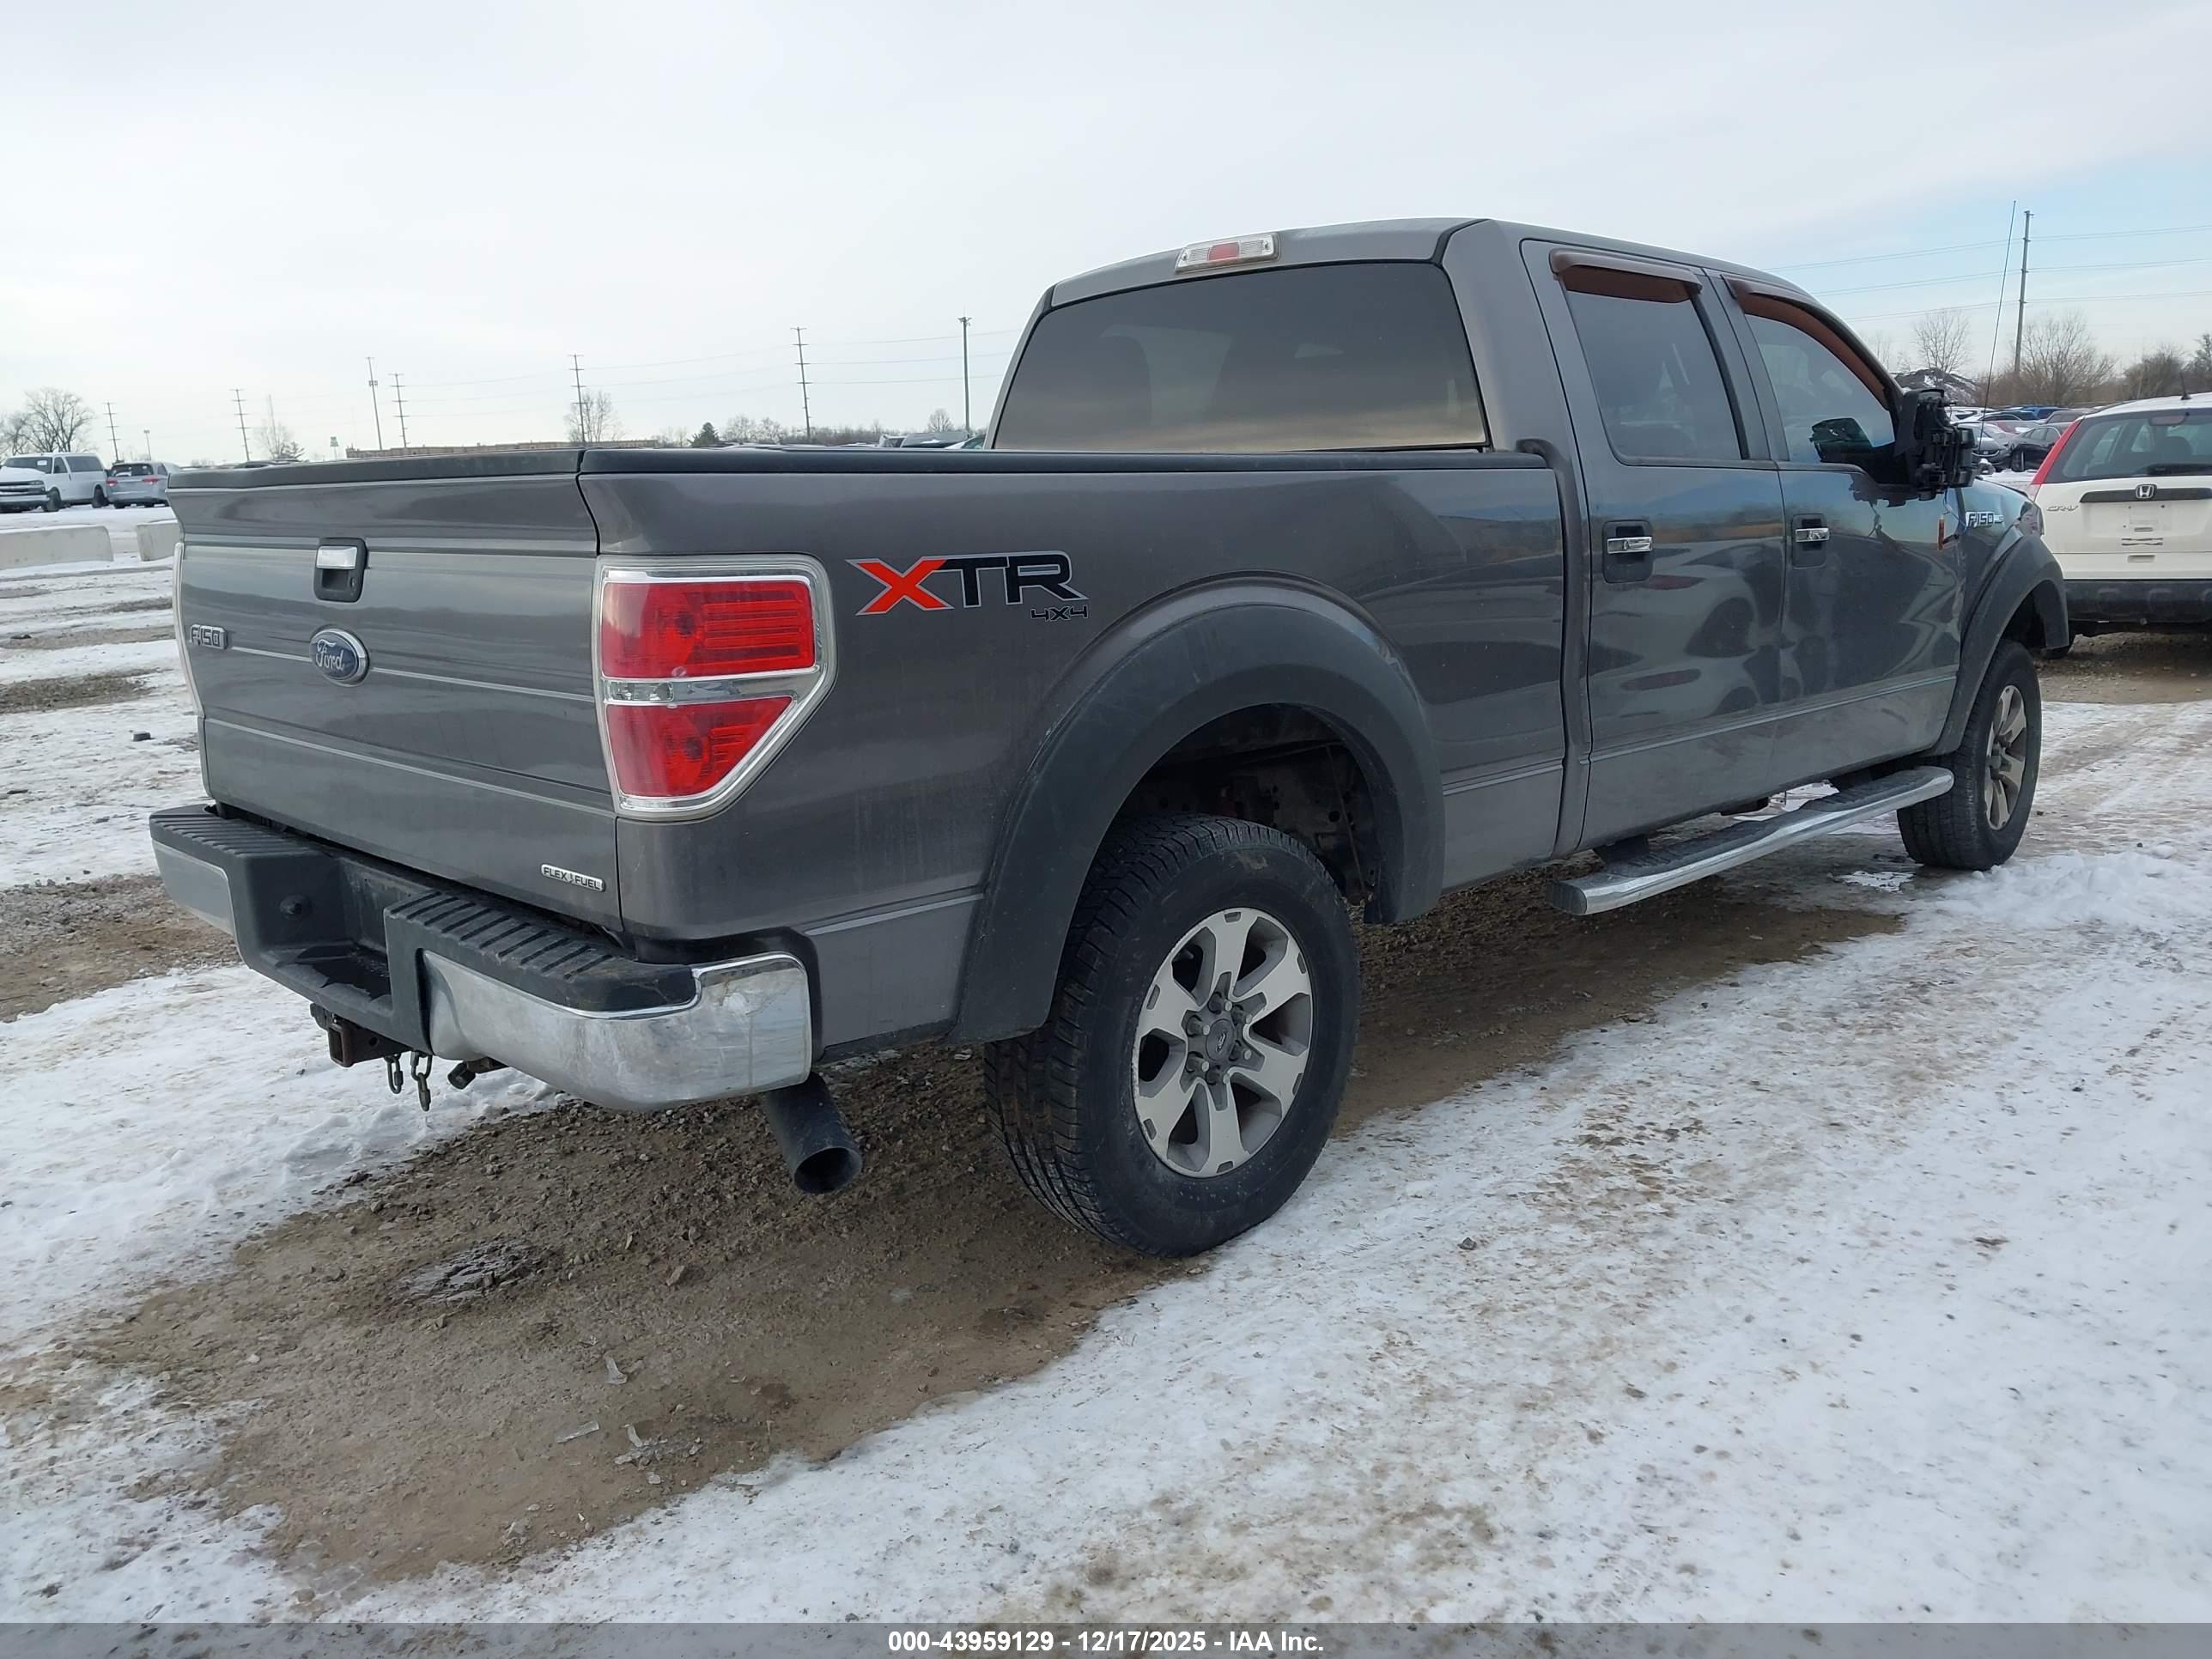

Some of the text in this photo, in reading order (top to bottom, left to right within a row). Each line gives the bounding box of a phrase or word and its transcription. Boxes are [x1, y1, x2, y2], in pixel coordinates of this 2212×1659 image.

[846, 550, 1089, 616] XTR
[315, 639, 344, 672] Ford
[544, 866, 601, 890] FLEX FUEL
